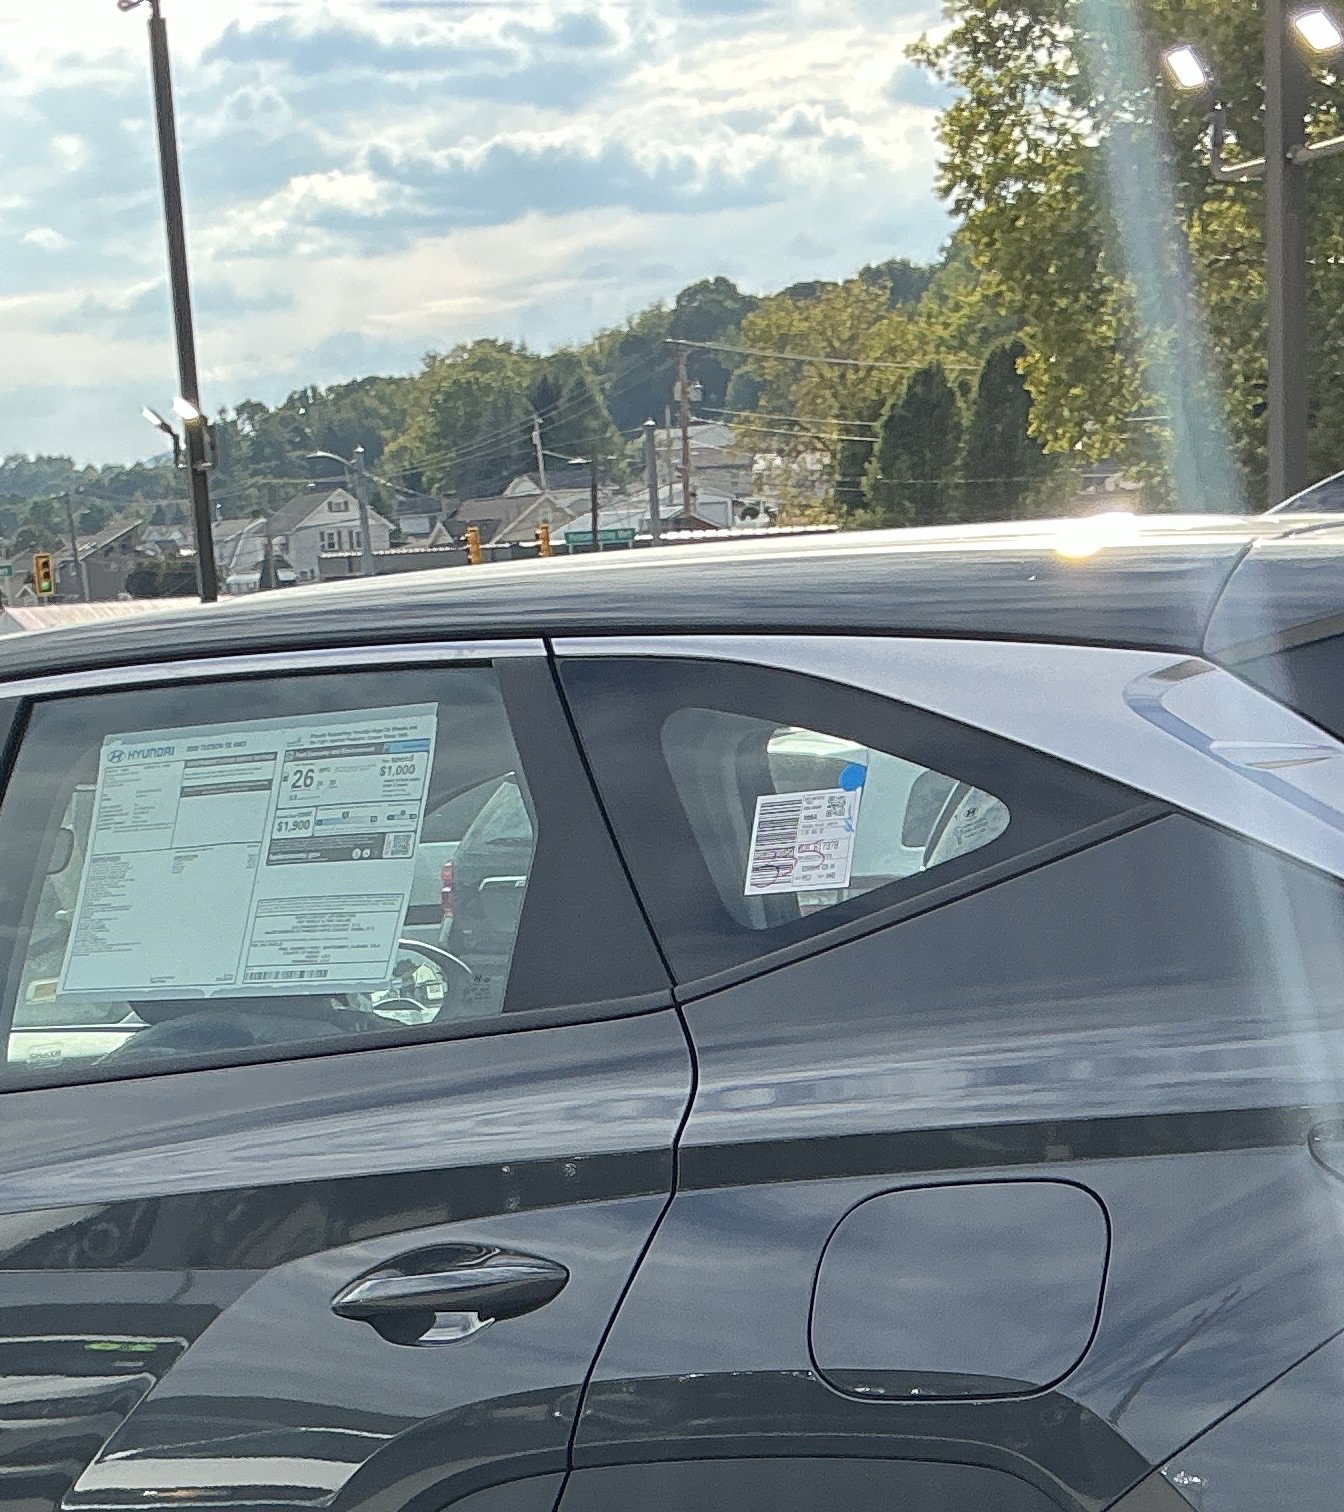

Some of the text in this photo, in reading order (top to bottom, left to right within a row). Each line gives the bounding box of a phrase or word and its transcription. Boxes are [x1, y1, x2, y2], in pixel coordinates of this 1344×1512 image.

[127, 745, 176, 761] HYUNDAI
[379, 763, 416, 777] $1,000
[290, 768, 315, 789] 26
